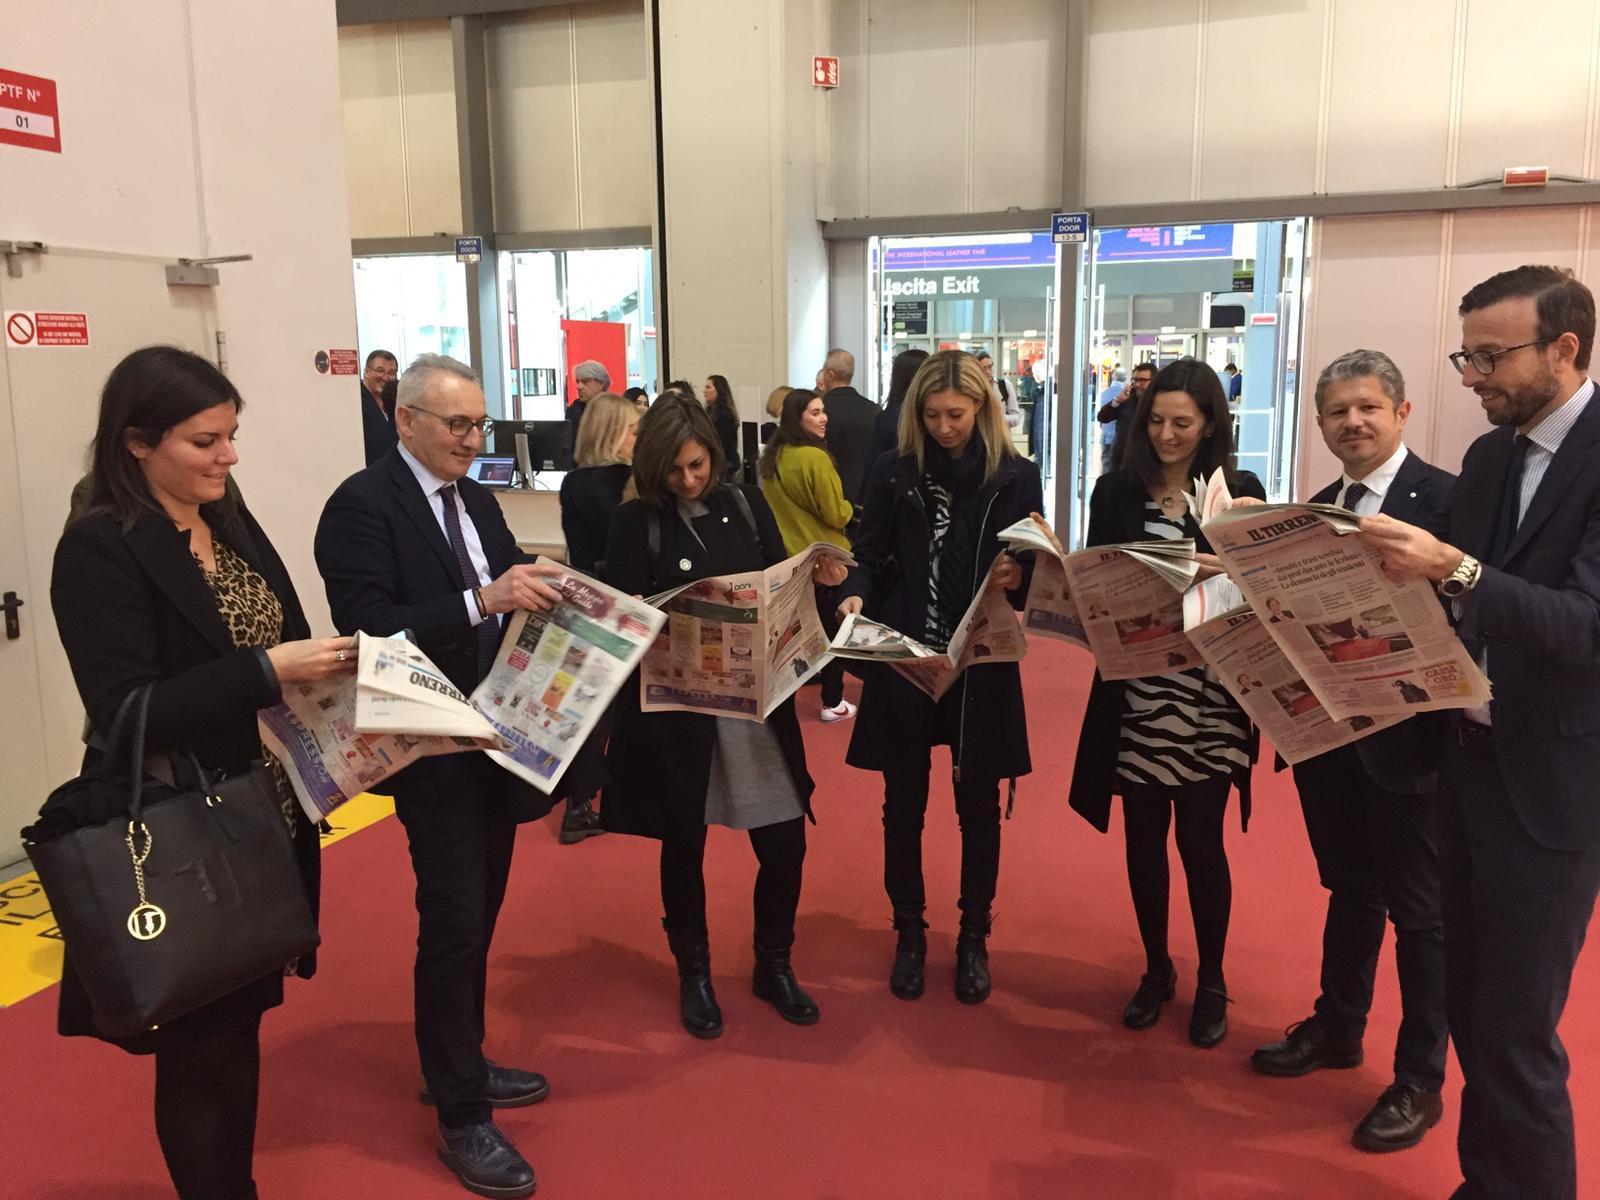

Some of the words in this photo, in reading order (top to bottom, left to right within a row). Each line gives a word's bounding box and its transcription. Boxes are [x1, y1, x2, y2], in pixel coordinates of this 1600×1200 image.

[0, 83, 23, 99] PTF
[16, 115, 29, 128] 01
[1057, 216, 1082, 224] PORTA
[946, 248, 971, 257] LEATHER
[943, 275, 980, 294] Exit
[1260, 513, 1319, 538] TIRREN
